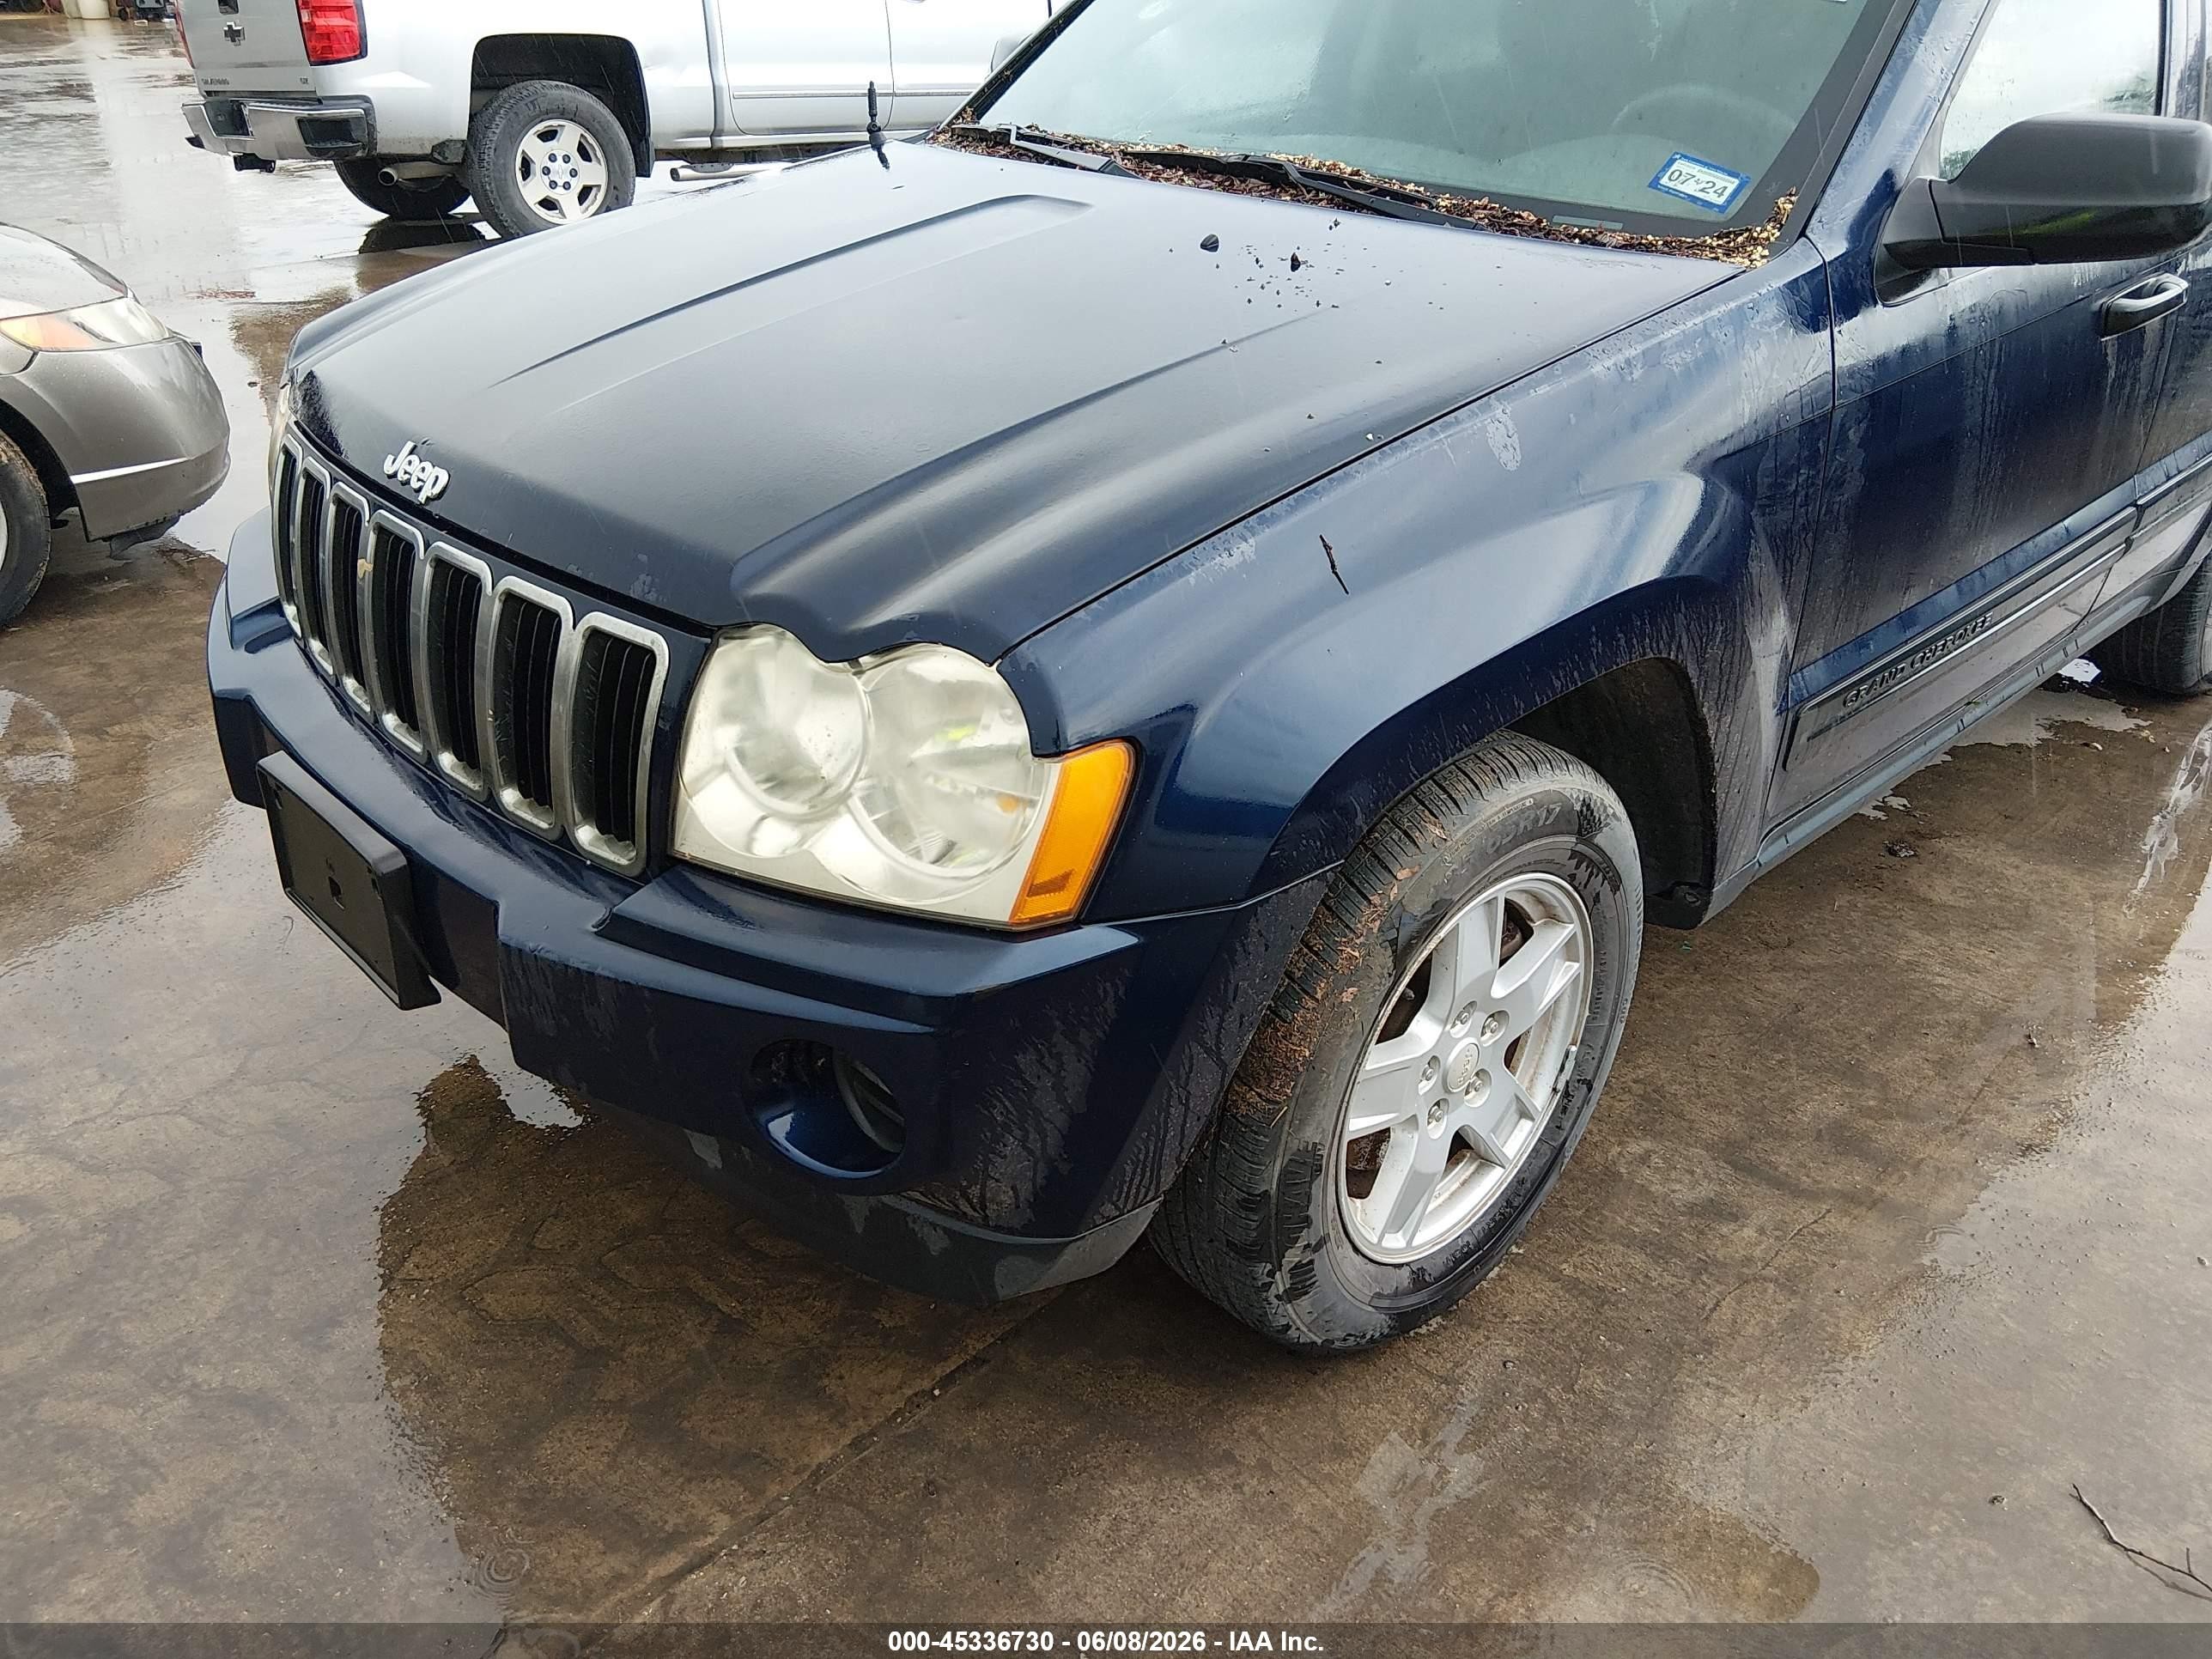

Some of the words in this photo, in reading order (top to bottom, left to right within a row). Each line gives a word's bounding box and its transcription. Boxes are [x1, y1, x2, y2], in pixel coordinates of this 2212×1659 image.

[1668, 168, 1696, 185] 07
[1698, 180, 1729, 198] 24
[384, 440, 451, 505] Jeep
[1843, 662, 1907, 708] GRAND
[1910, 611, 1994, 670] CHEROKEE
